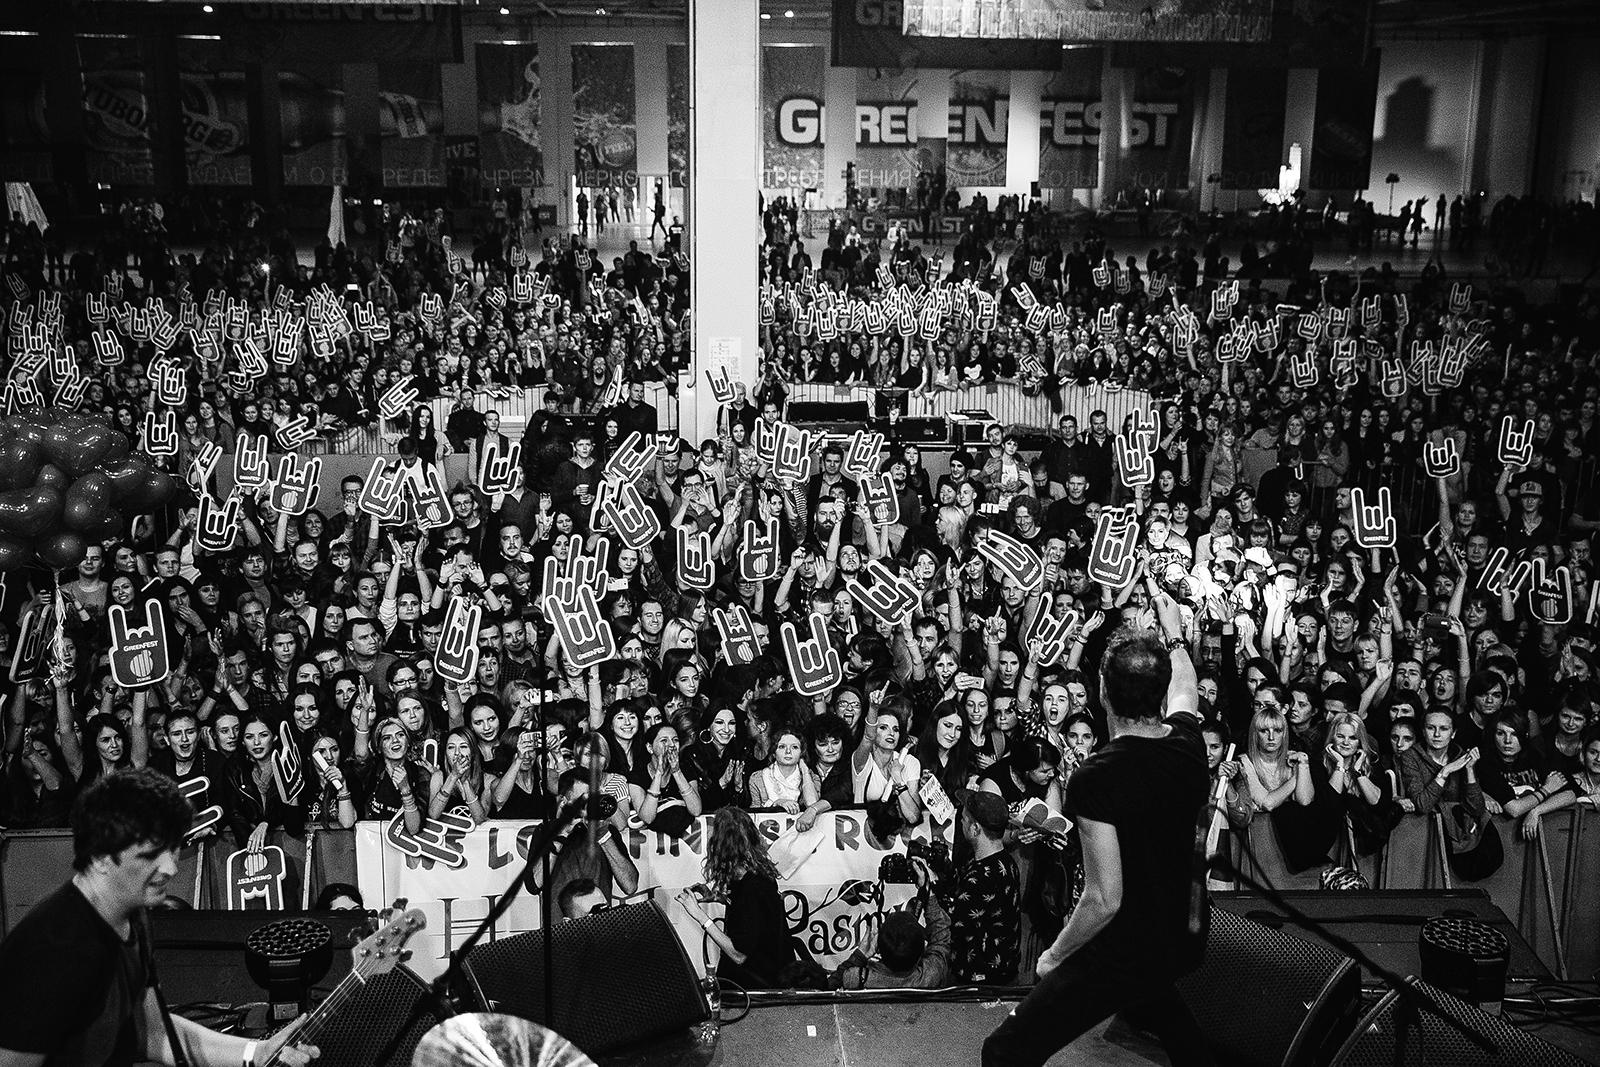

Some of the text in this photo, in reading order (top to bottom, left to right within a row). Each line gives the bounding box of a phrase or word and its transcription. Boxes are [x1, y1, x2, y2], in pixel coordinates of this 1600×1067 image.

[123, 640, 158, 652] GREENFEST
[805, 674, 833, 689] GREENFEST
[237, 873, 272, 885] GREENFEST
